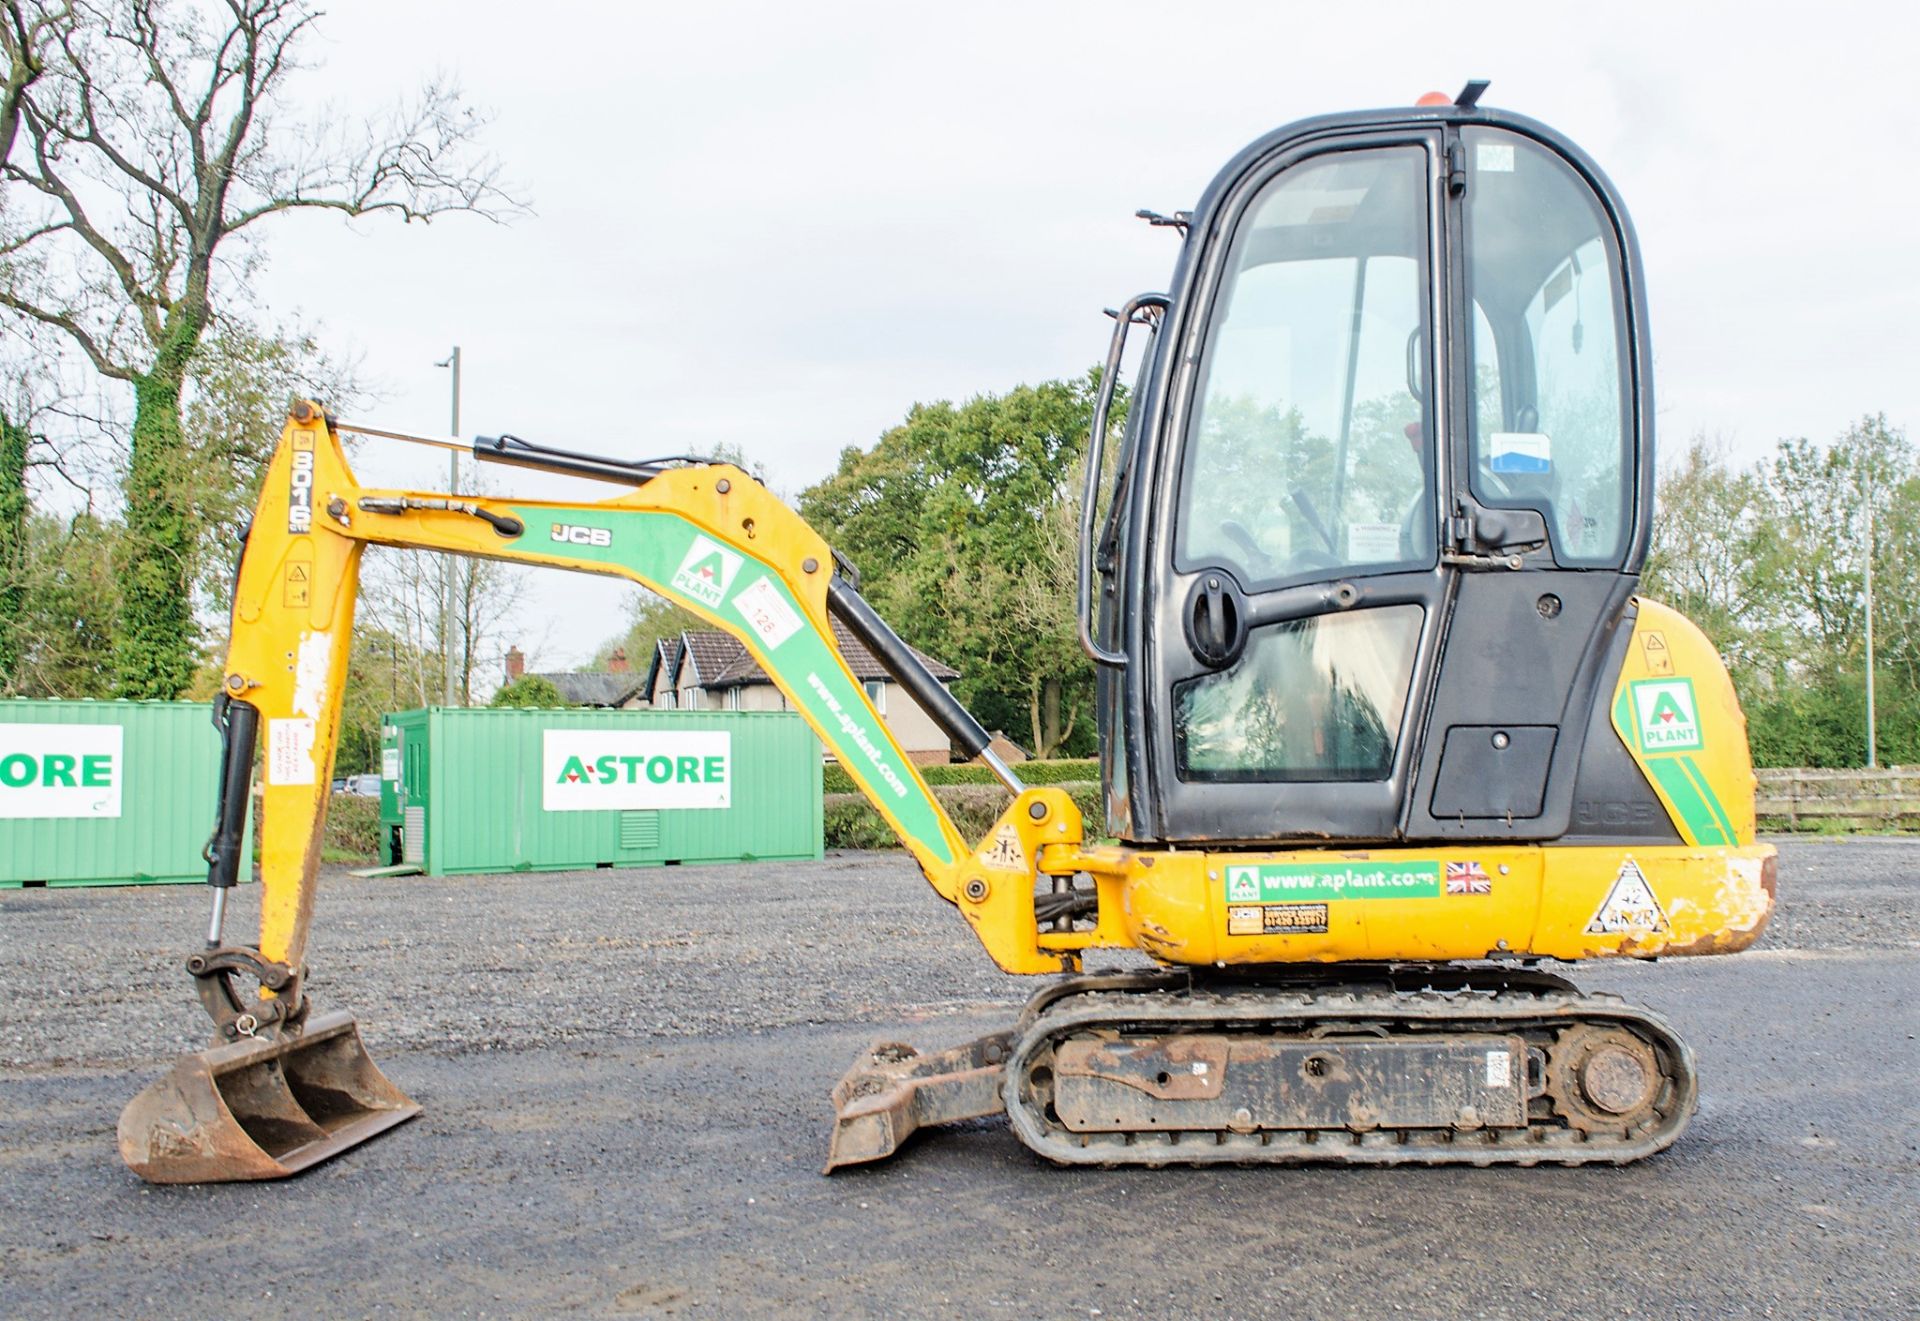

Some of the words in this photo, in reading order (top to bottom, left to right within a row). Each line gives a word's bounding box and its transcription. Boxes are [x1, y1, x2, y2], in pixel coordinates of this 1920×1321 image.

[289, 451, 313, 524] 8016
[552, 525, 612, 547] JCB
[688, 550, 724, 587] A
[676, 574, 720, 603] PLANT
[1649, 691, 1689, 725] A
[807, 672, 908, 798] www.aplant.com
[1646, 728, 1695, 743] PLANT
[1578, 801, 1655, 825] JCB
[1263, 870, 1434, 892] www.aplant.com
